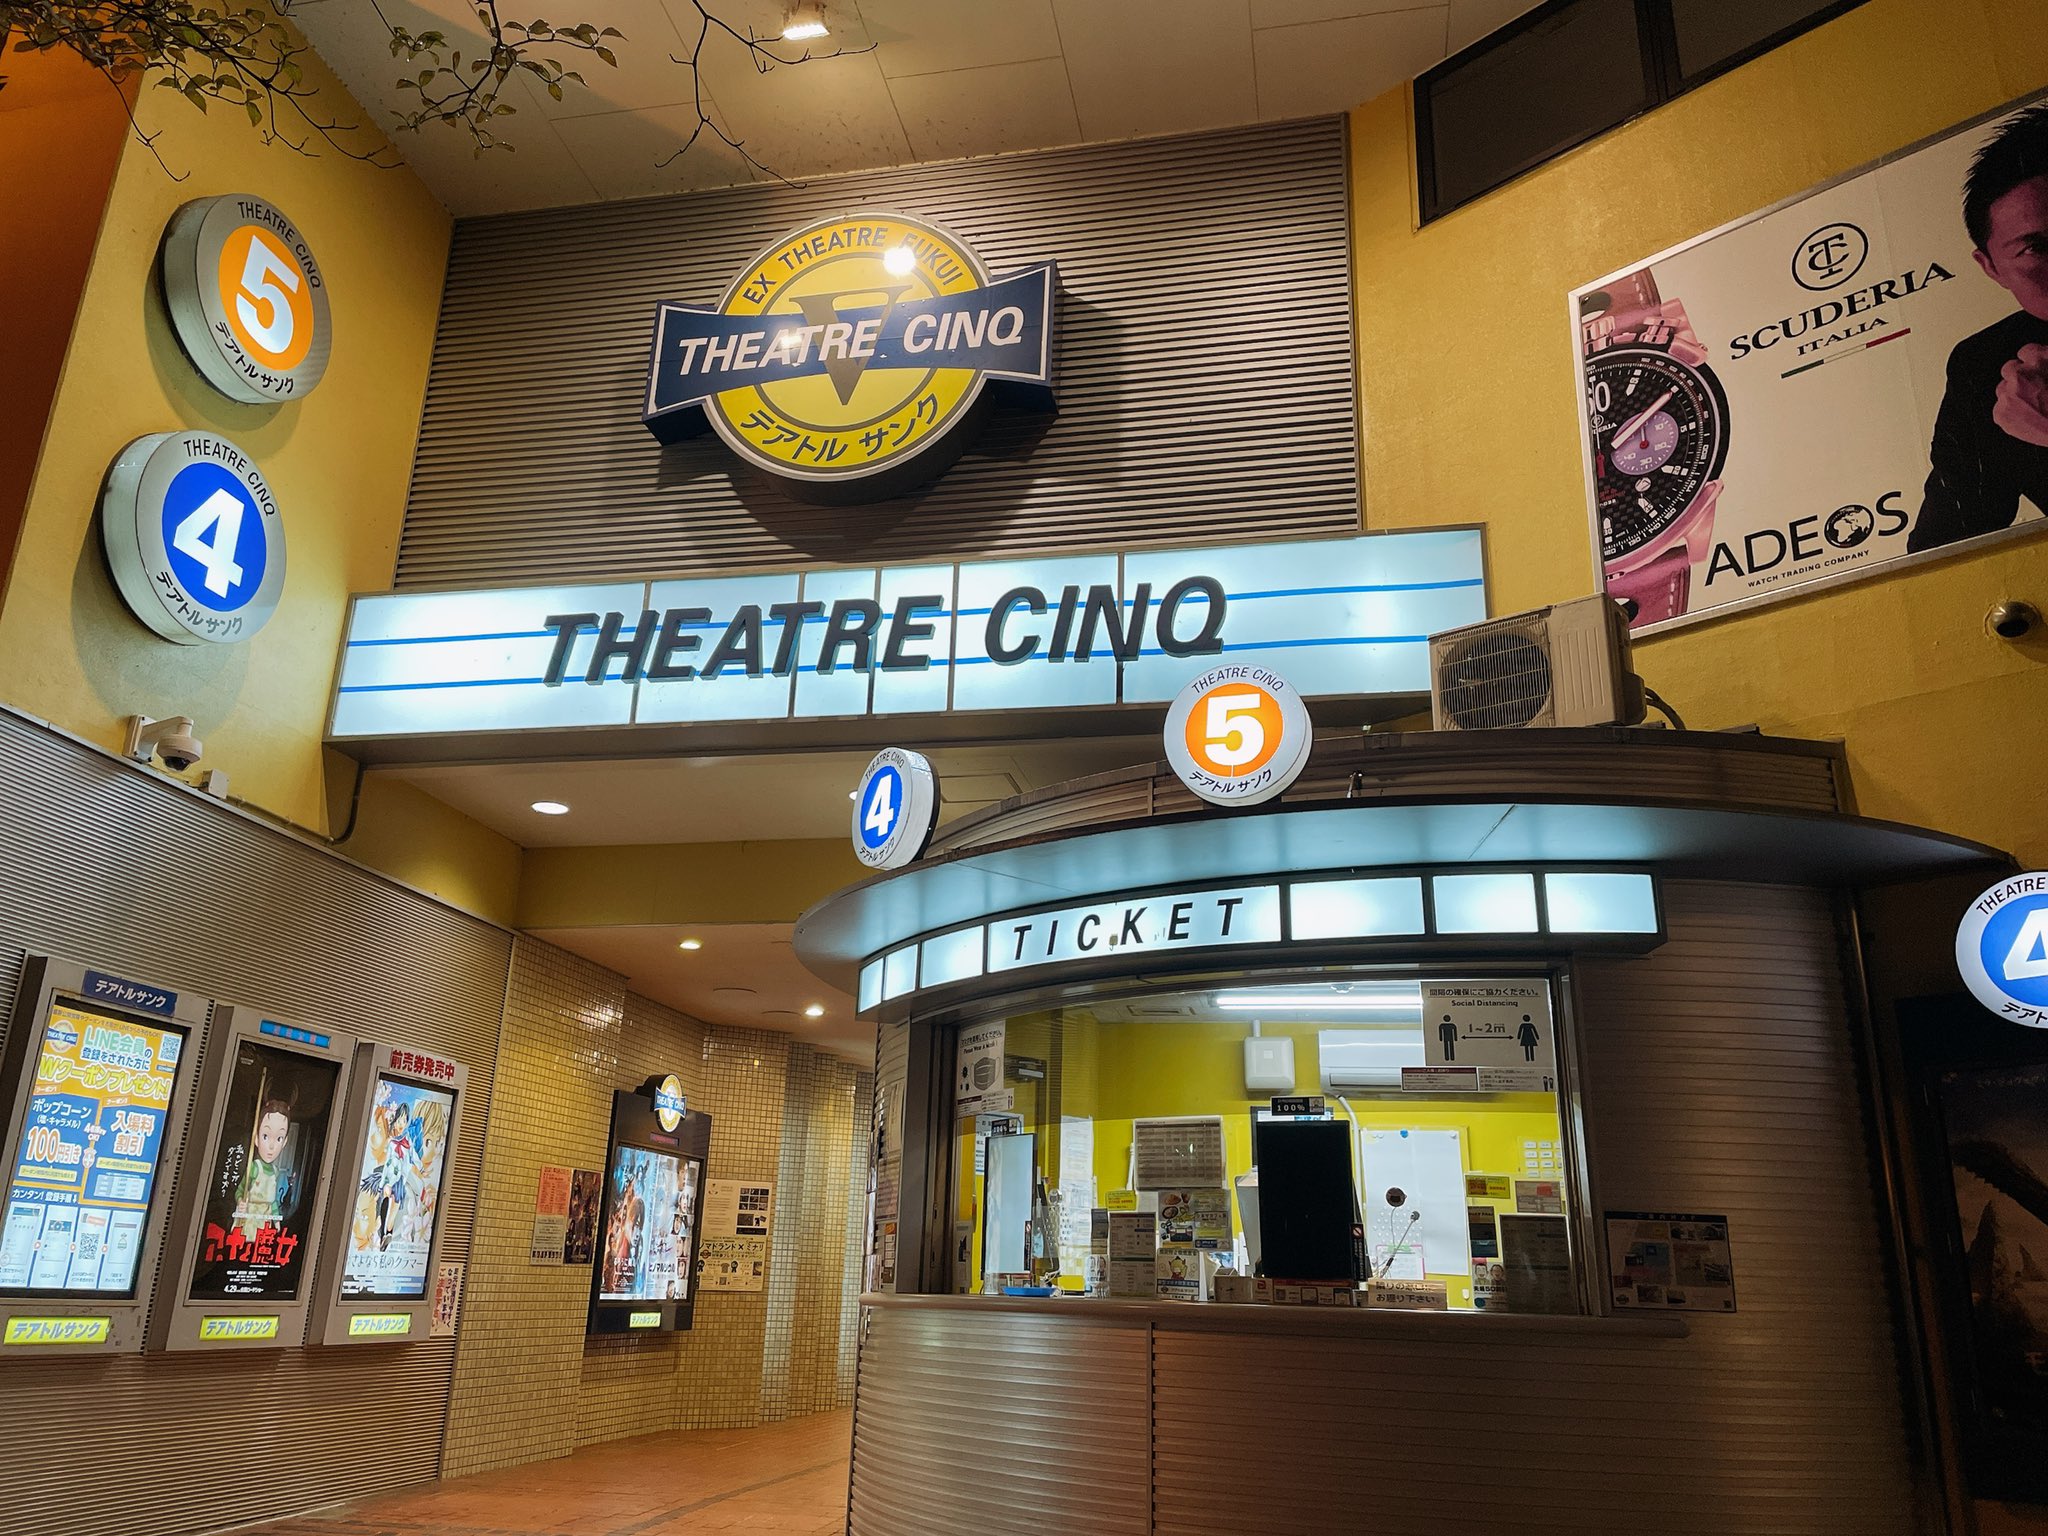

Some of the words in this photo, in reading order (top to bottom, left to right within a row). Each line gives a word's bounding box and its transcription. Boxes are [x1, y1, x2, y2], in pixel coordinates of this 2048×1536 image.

[237, 201, 295, 243] THEATRE
[294, 243, 322, 291] CINQ
[743, 272, 777, 305] EX
[778, 226, 889, 271] THEATRE
[900, 232, 965, 287] FUKUI
[235, 234, 300, 355] 5
[1729, 261, 1956, 361] SCUDERIA
[678, 318, 882, 376] THEATRE
[902, 306, 1025, 355] CINQ
[1797, 316, 1889, 357] ITALIA
[183, 438, 247, 475] THEATRE
[247, 471, 276, 518] CINQ
[172, 486, 245, 599] 4
[1748, 575, 1780, 589] WATCH
[1781, 563, 1822, 581] TRADING
[1824, 549, 1871, 570] COMPANY
[542, 594, 944, 688] THEATRE
[984, 574, 1228, 665] CINQ
[1192, 667, 1249, 694] THEATRE
[1252, 669, 1284, 692] CINQ
[1204, 693, 1265, 767] 5
[865, 751, 890, 780] THEATRE
[891, 751, 904, 769] CINQ
[865, 774, 894, 837] 4
[1976, 877, 2046, 915] THEATRE
[1013, 897, 1243, 960] TICKET
[95, 980, 167, 1008] テアトルサンク
[1429, 988, 1540, 996] 間隔の確保にご協力ください。
[81, 1047, 151, 1071] 登録をされた方に
[84, 1026, 153, 1059] LINE会員の
[390, 1050, 456, 1081] 前売券発売中
[32, 1099, 92, 1119] ポップコーン
[111, 1110, 156, 1136] 入場料
[1277, 1104, 1305, 1112] 100%
[26, 1126, 83, 1165] 100円引き
[113, 1134, 146, 1157] 割引
[351, 1255, 424, 1269] さよなら私のクラマー
[13, 1322, 101, 1340] テアトルサンク
[206, 1320, 272, 1337] テアトルサンク
[354, 1318, 406, 1331] テアトルサンク
